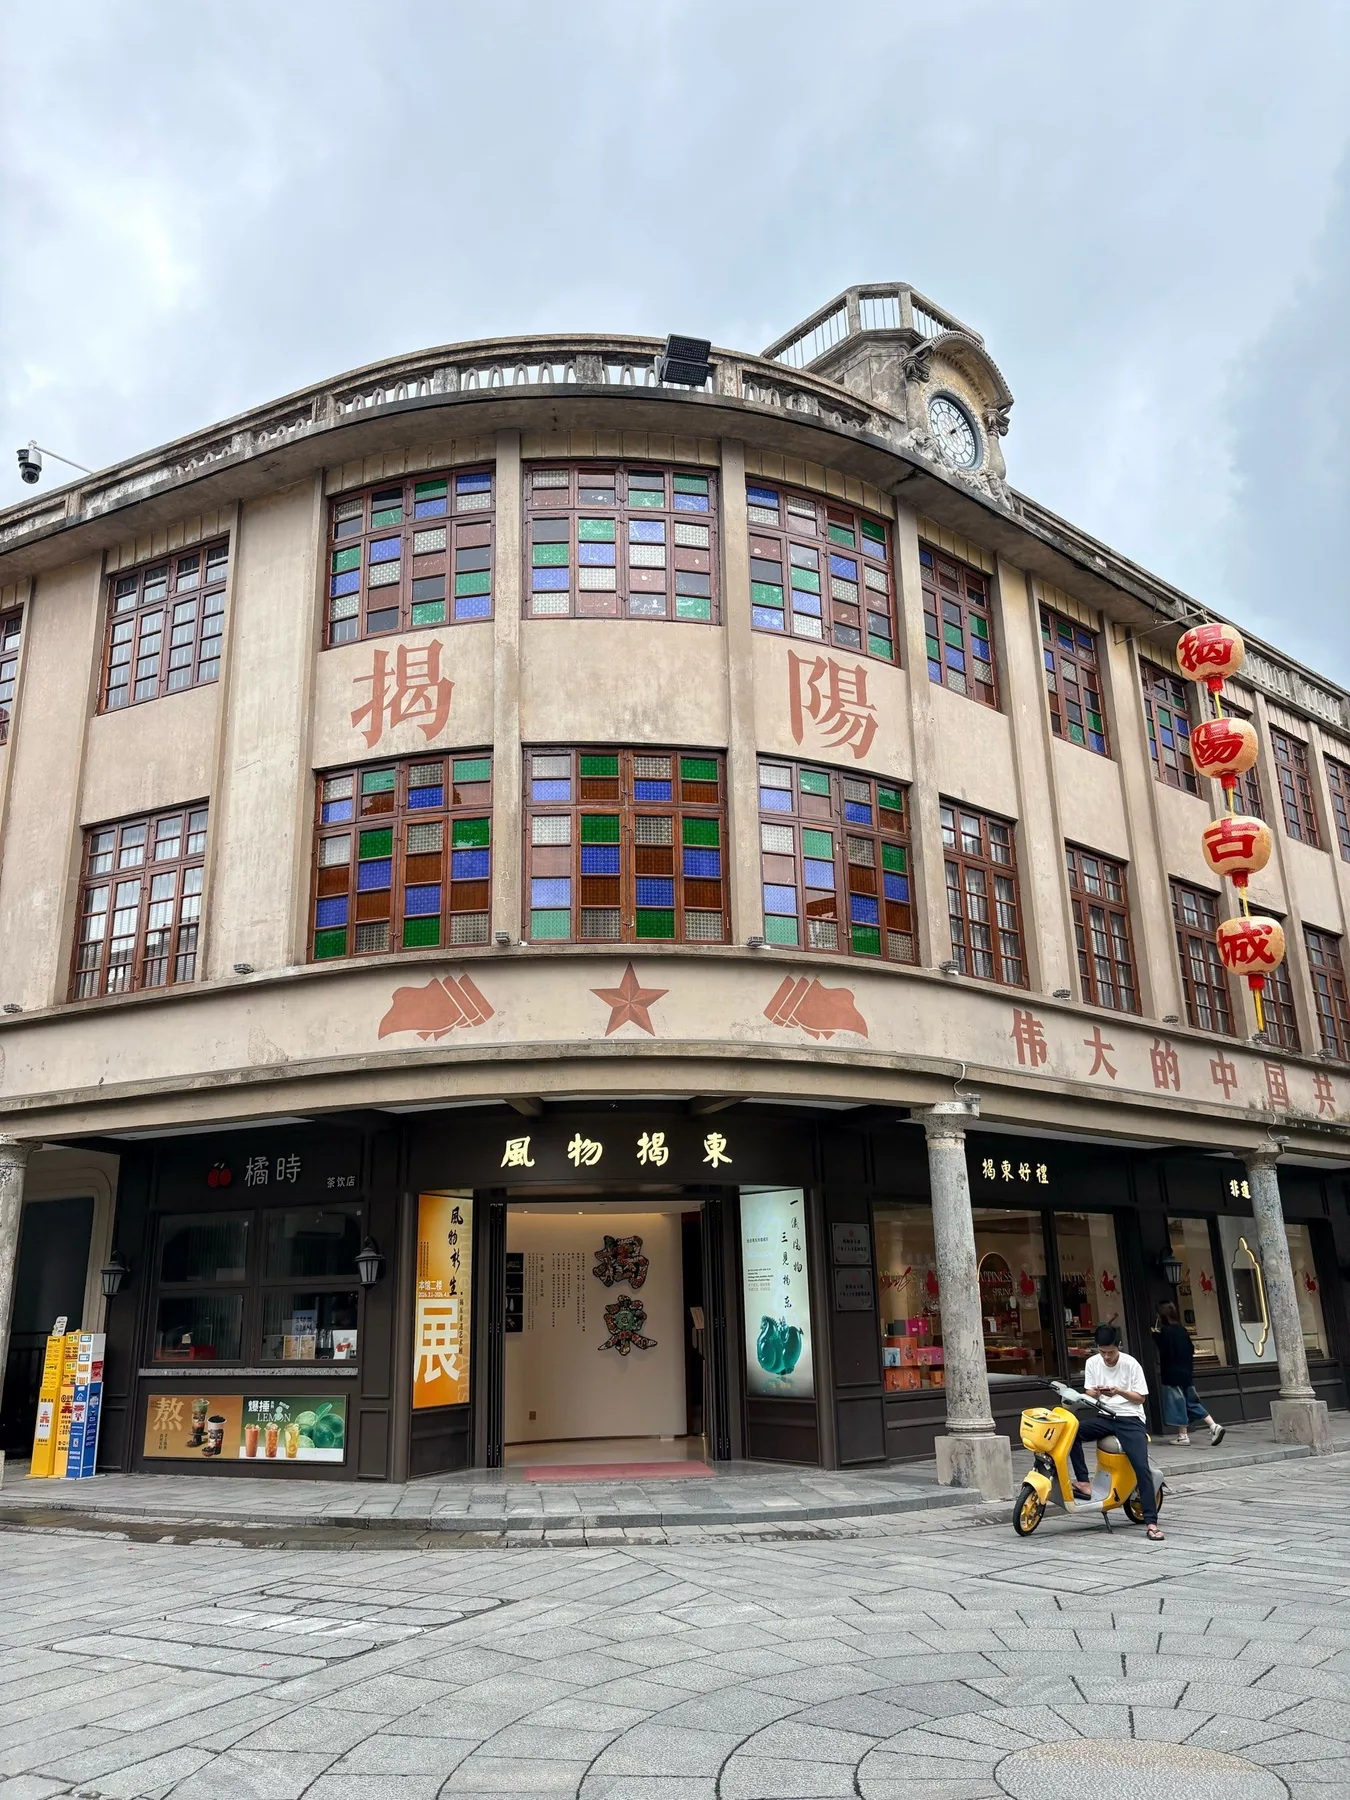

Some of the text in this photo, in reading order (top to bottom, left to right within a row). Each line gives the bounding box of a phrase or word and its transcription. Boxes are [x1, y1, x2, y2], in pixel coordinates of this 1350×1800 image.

[1178, 624, 1234, 672] 揭
[350, 638, 879, 760] 揭 陽
[1191, 718, 1244, 768] 陽
[1204, 818, 1260, 863] 古
[1217, 921, 1276, 968] 城
[1009, 1007, 1336, 1118] 伟大的中国共
[244, 1153, 302, 1187] 橘時
[501, 1132, 732, 1168] 風物揭東
[982, 1158, 1049, 1184] 揭東好禮
[326, 1175, 356, 1188] 茶饮店
[413, 1299, 460, 1384] 展
[153, 1396, 185, 1431] 熬
